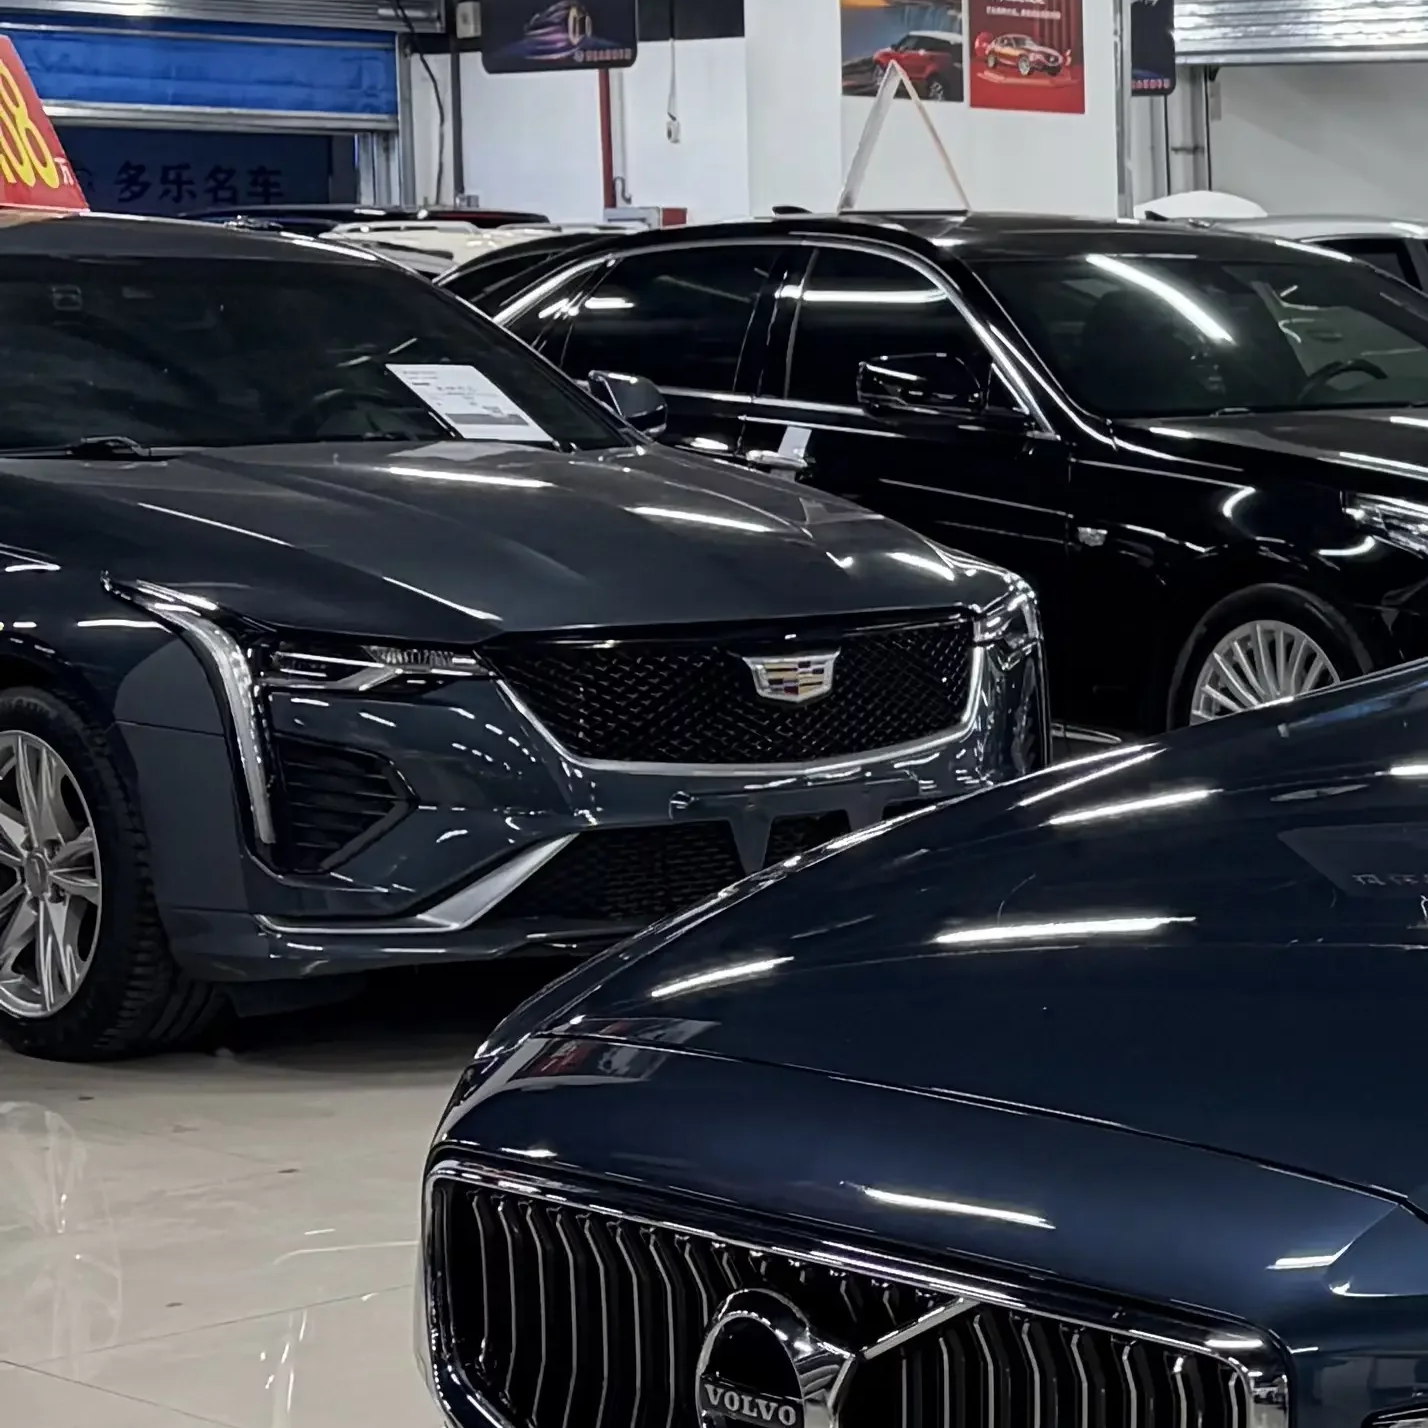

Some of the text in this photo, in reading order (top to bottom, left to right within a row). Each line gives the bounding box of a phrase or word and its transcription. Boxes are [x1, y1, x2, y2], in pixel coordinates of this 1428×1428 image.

[114, 160, 285, 204] 多乐名车
[704, 1382, 797, 1428] VOLVO
